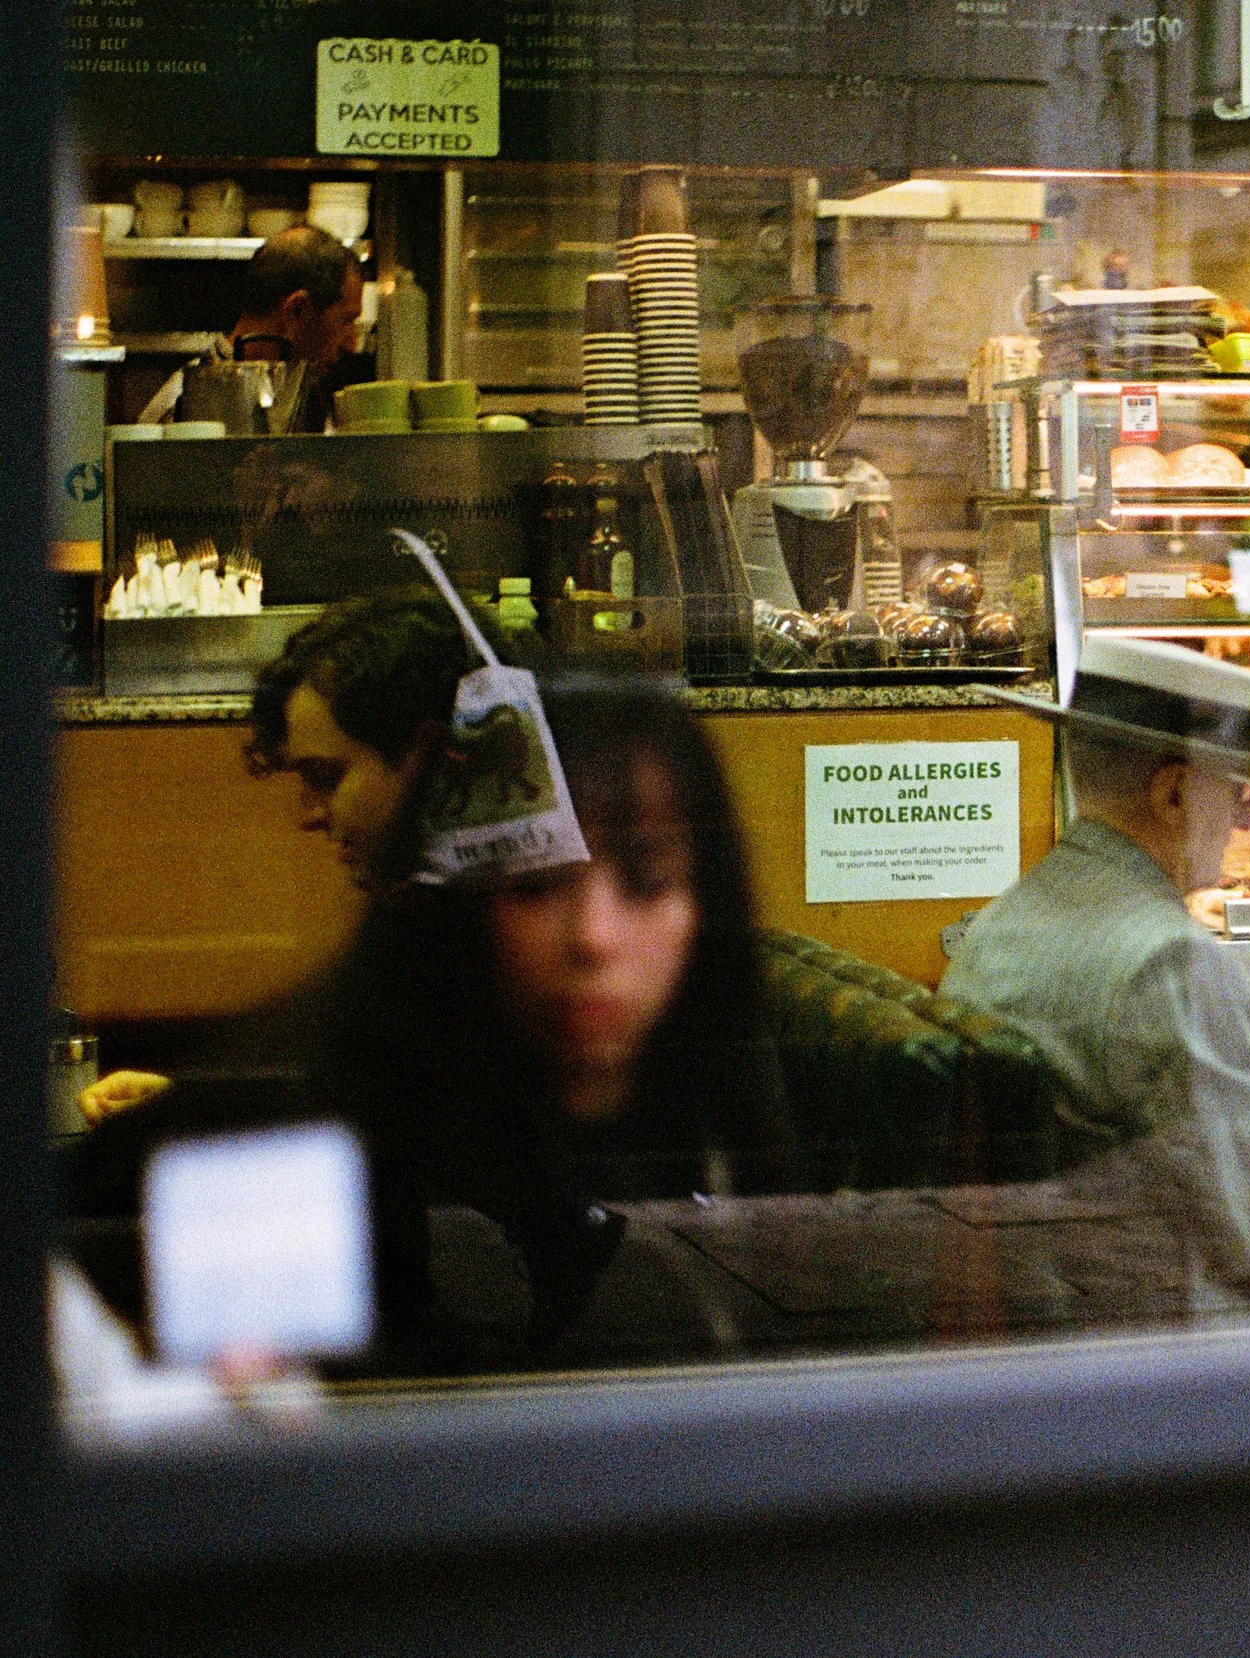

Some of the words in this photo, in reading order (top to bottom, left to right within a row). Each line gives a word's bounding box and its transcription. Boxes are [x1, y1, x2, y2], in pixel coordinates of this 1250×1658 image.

[329, 43, 392, 63] CASH
[401, 45, 414, 64] &
[422, 45, 488, 65] CARD
[156, 60, 207, 74] CHICKEN
[338, 102, 480, 124] PAYMENTS
[345, 132, 472, 151] ACCEPTED
[823, 765, 883, 782] FOOD
[888, 762, 1001, 781] ALLERGIES
[897, 785, 928, 799] and
[833, 804, 993, 824] INTOLERANCES
[820, 849, 847, 858] Please
[849, 849, 873, 859] speak
[874, 848, 884, 857] to
[884, 849, 898, 857] our
[900, 847, 917, 856] staff
[919, 846, 942, 855] about
[943, 845, 957, 854] the
[958, 844, 1004, 855] ingredients
[836, 861, 845, 869] in
[846, 862, 865, 871] your
[890, 859, 912, 868] when
[914, 858, 943, 868] making
[944, 857, 963, 867] your
[891, 872, 915, 882] Thank
